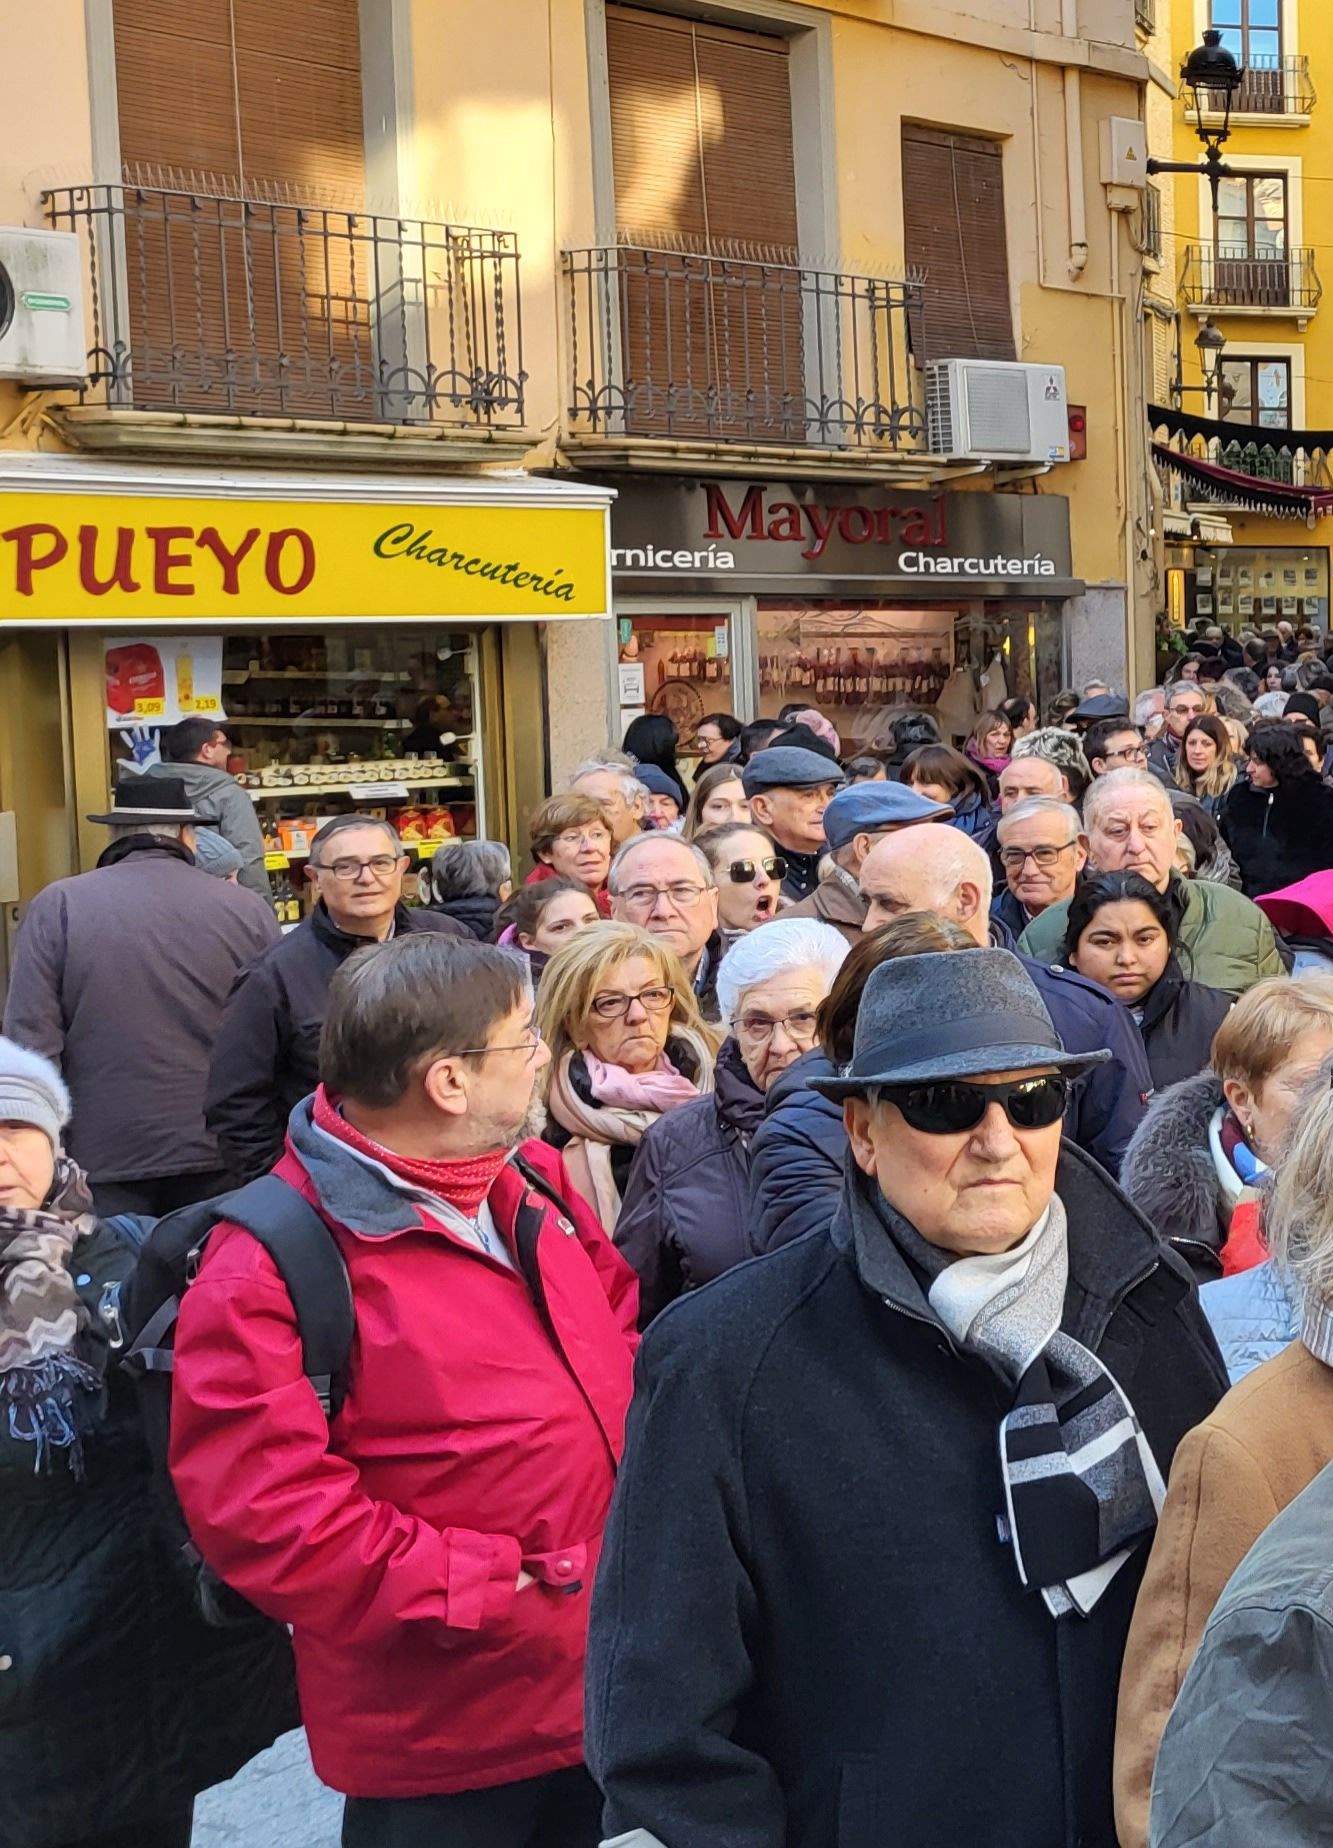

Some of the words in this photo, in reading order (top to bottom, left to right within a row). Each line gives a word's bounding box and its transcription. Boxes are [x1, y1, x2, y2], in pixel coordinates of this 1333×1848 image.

[701, 484, 947, 560] Mayoral
[2, 523, 316, 595] PUEYO
[373, 522, 577, 602] Charcutería
[898, 551, 1055, 576] Charcutería
[136, 702, 161, 714] 3,09
